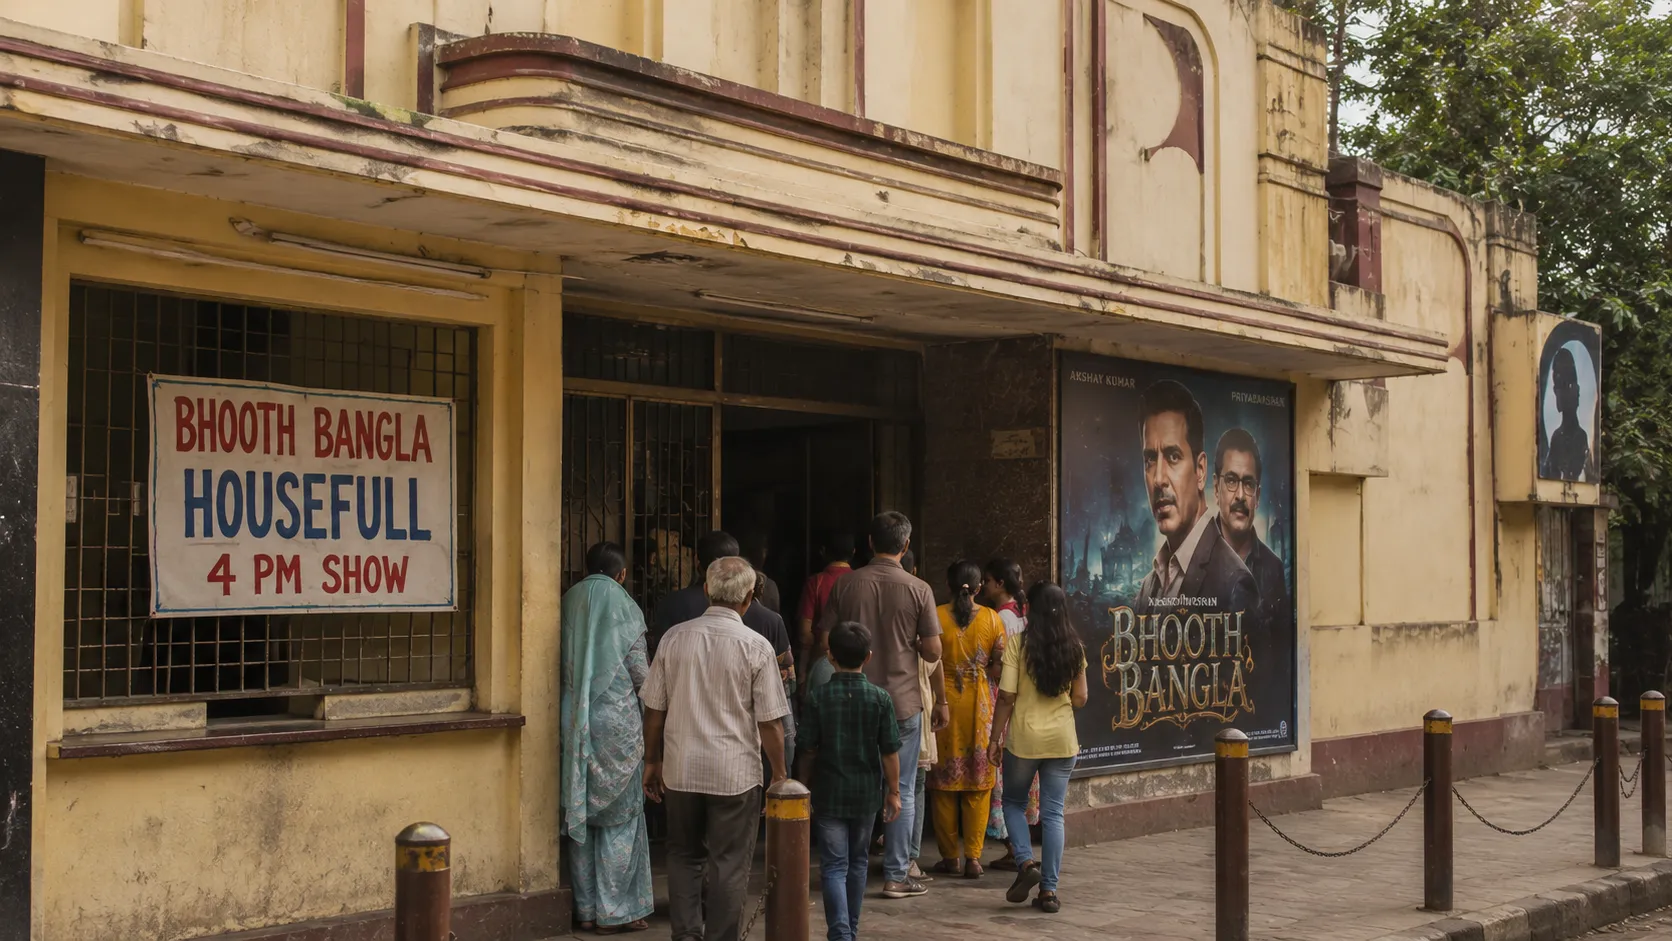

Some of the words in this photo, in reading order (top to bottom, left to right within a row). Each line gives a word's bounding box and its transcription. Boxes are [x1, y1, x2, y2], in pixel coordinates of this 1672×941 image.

[1069, 370, 1104, 384] AKSHAY
[1105, 375, 1136, 388] KUMAR
[174, 396, 296, 456] BHOOTH
[314, 407, 433, 463] BANGLA
[184, 468, 432, 541] HOUSEFULL
[207, 553, 236, 596] 4
[254, 554, 302, 595] PM
[322, 554, 409, 594] SHOW
[1105, 605, 1246, 667] BHOOTH
[1112, 660, 1255, 731] BANGLA
